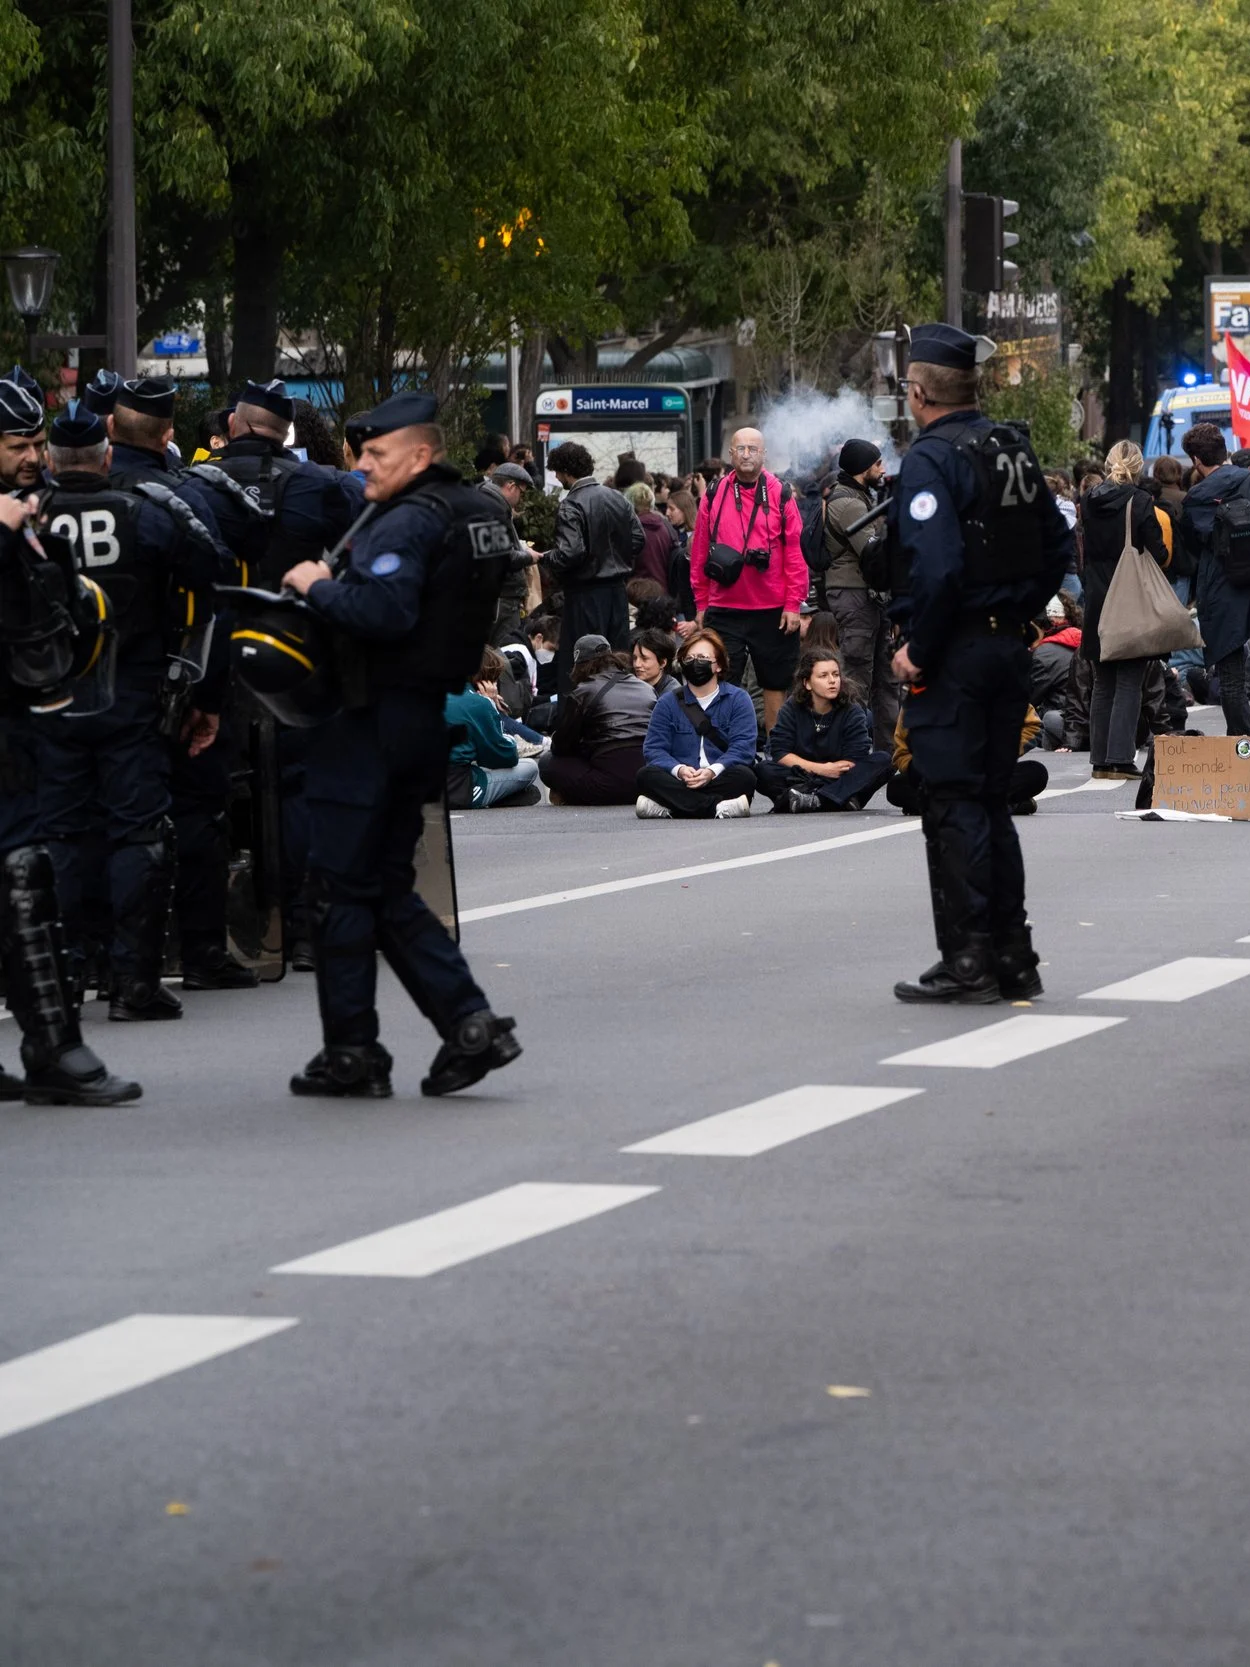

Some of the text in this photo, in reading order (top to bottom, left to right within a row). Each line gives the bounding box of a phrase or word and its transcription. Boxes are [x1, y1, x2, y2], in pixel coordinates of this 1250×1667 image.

[576, 397, 650, 411] Saint-Marcel
[996, 451, 1038, 507] 2C
[50, 509, 121, 568] 2B
[1157, 739, 1187, 756] Tout
[1157, 759, 1176, 776] Le
